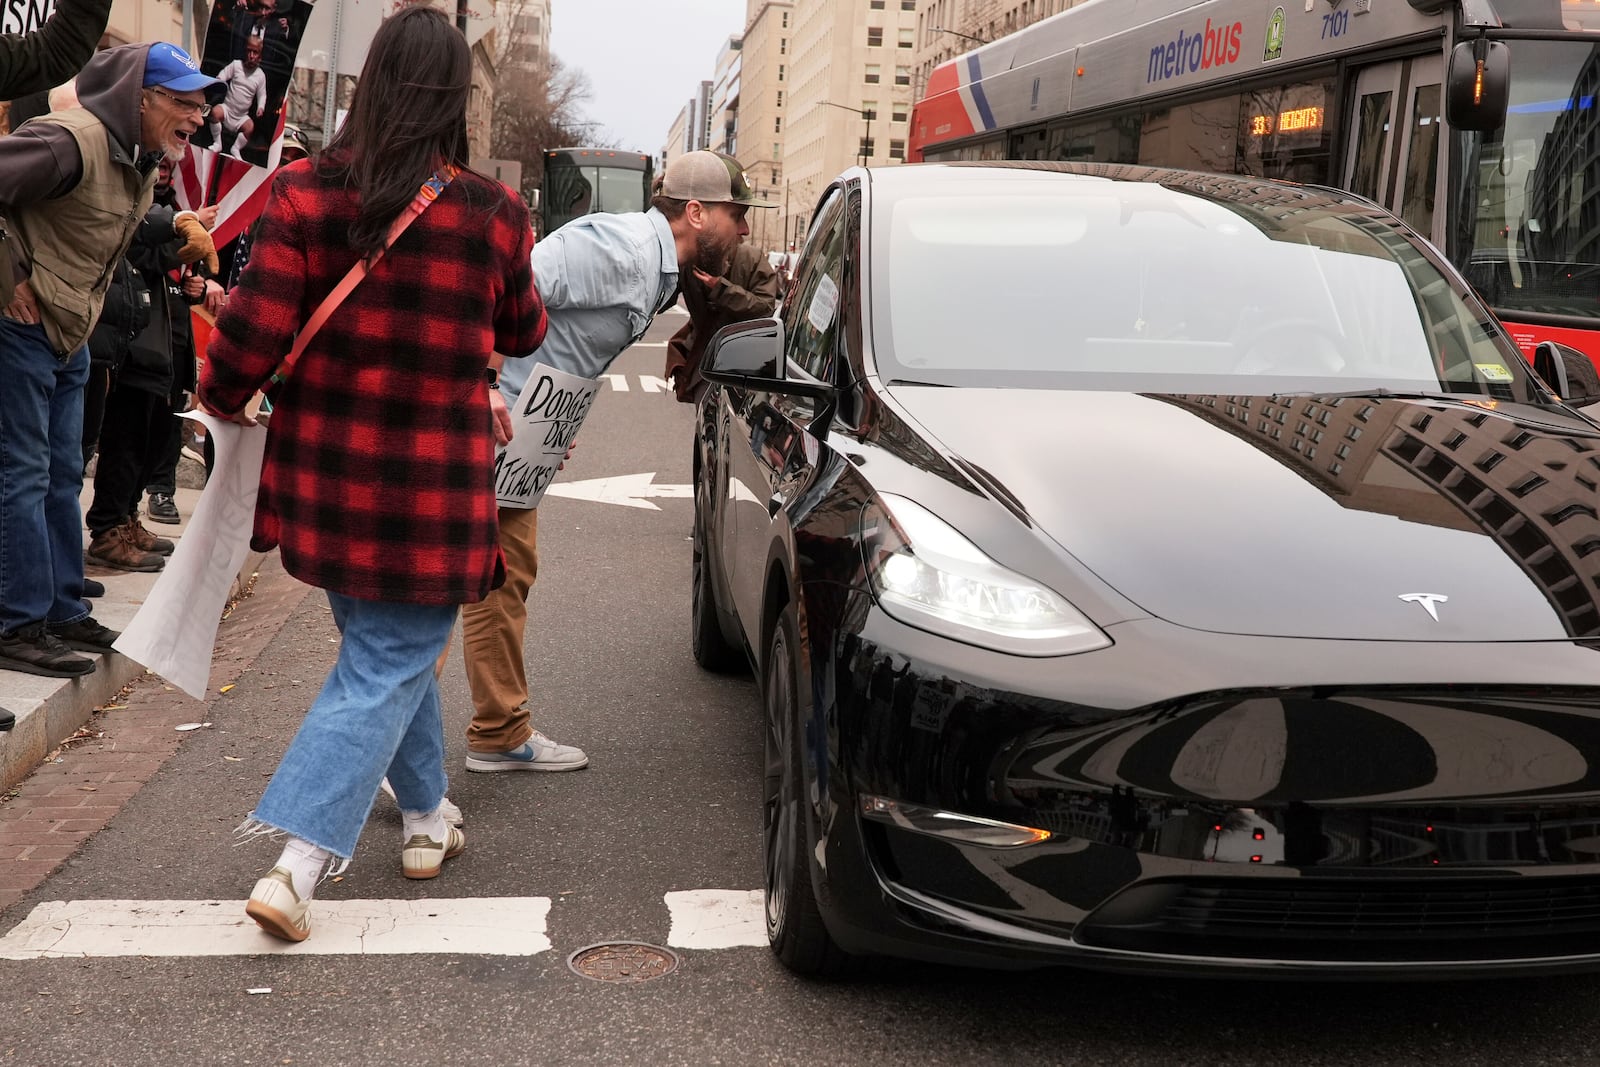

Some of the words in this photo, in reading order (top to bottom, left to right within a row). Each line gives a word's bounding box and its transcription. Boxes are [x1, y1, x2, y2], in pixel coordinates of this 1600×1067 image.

[1322, 9, 1348, 40] 7101
[1147, 18, 1242, 83] metrobus
[1280, 107, 1318, 130] HEIGHTS
